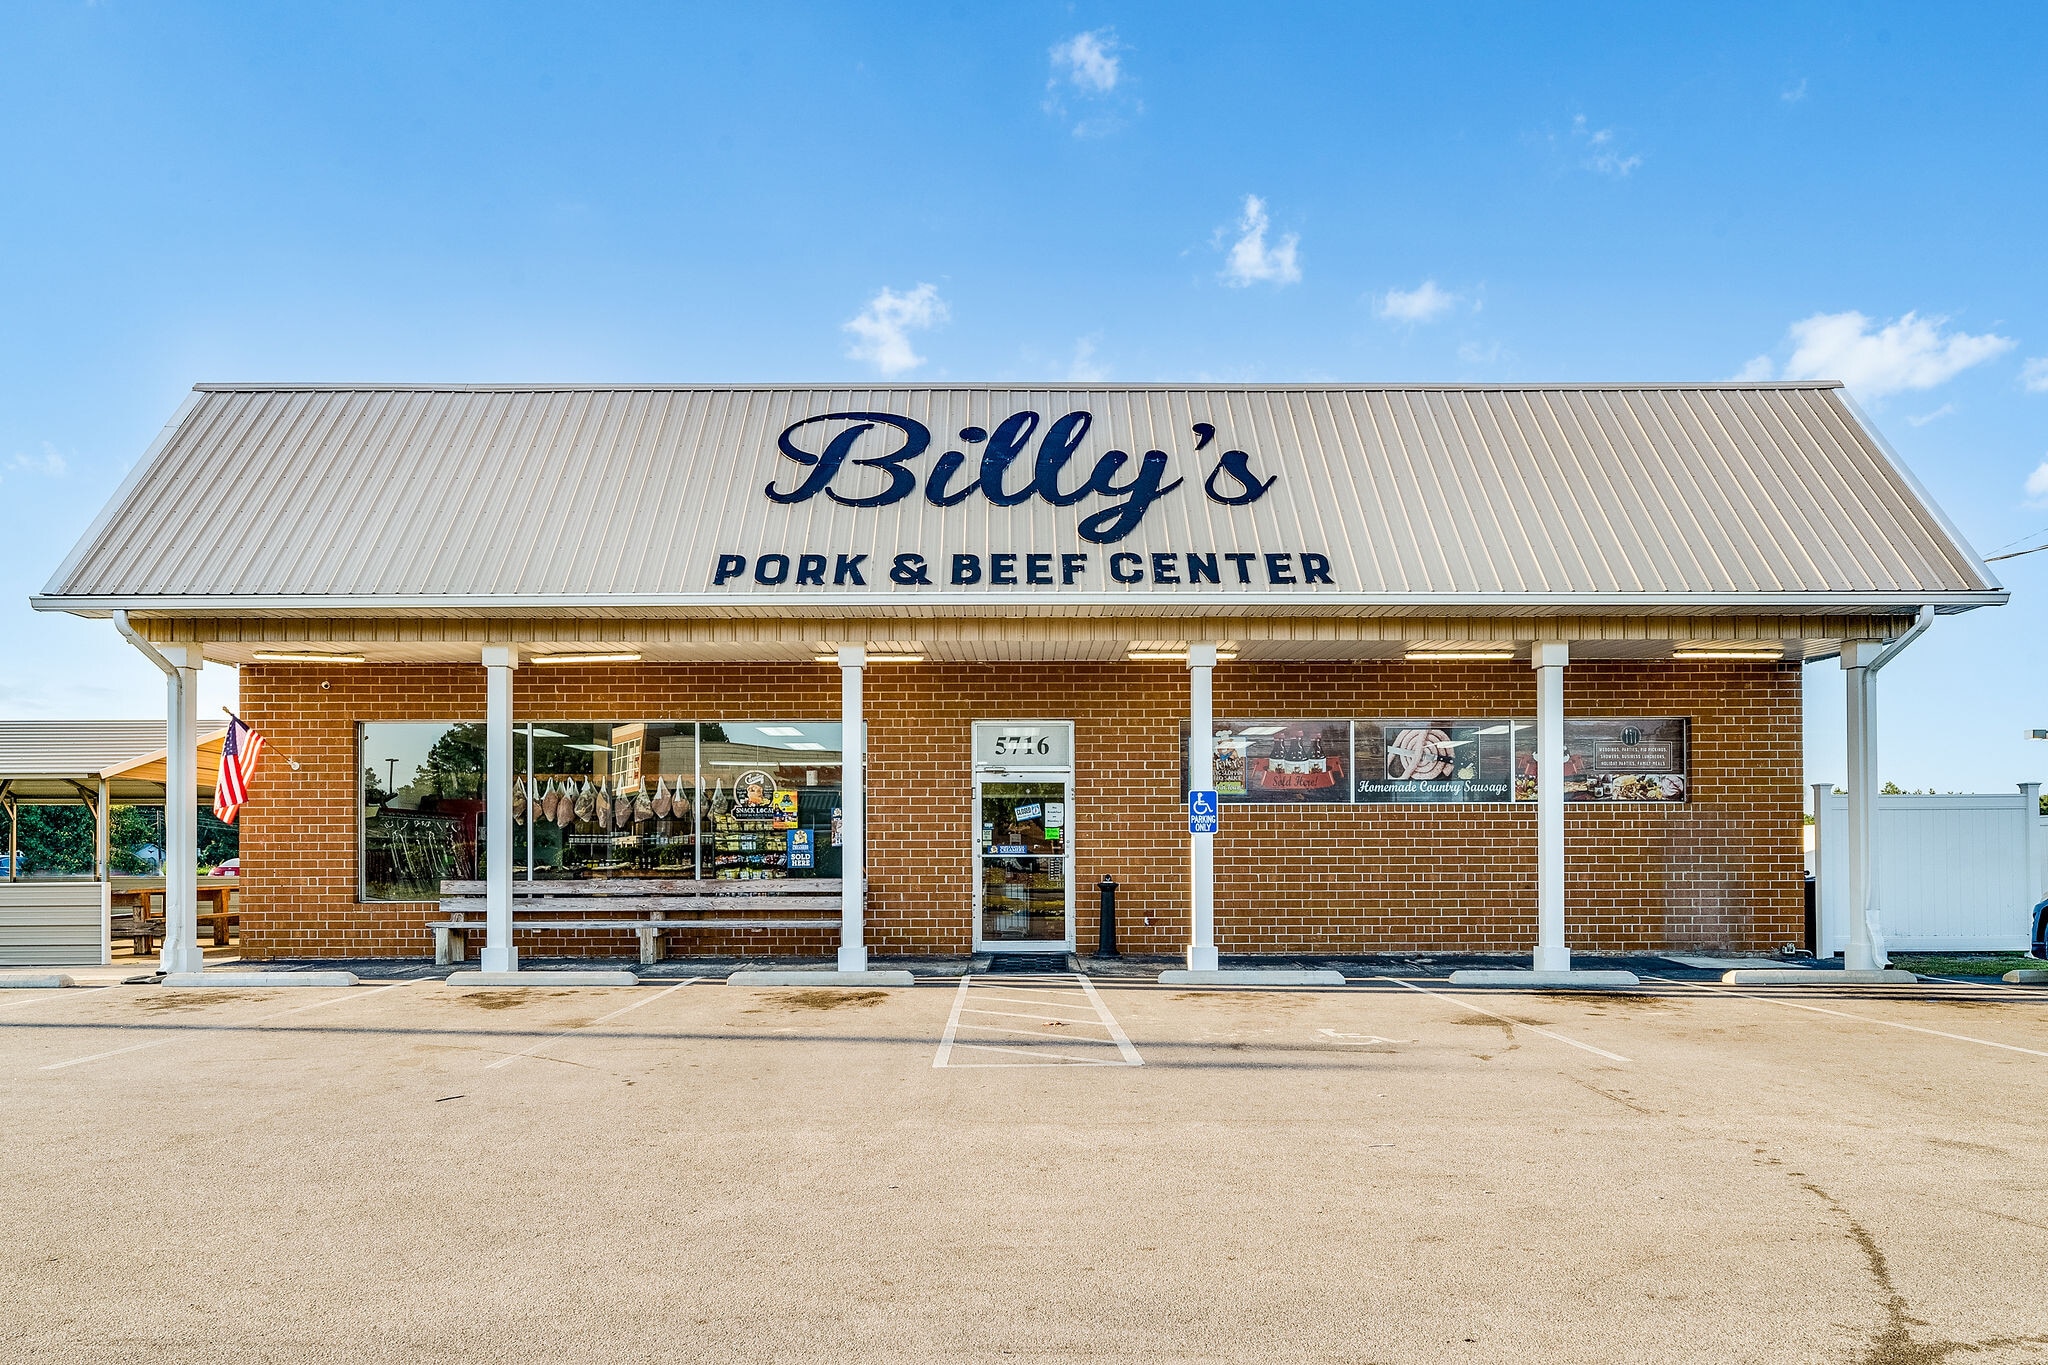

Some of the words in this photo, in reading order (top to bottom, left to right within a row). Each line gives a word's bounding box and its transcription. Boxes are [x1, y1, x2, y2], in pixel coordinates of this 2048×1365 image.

[764, 410, 1278, 545] Billy's
[712, 553, 869, 586] PORK
[889, 553, 933, 586] &
[950, 553, 1088, 585] BEEF
[1109, 552, 1335, 585] CENTER
[995, 736, 1050, 755] 5716
[1272, 775, 1291, 787] Sold
[1294, 775, 1318, 787] Here!
[1357, 780, 1417, 793] Homemade
[1420, 781, 1462, 795] Country
[1464, 780, 1508, 795] Sausage
[1190, 815, 1216, 824] PARKING
[1195, 823, 1212, 832] ONLY
